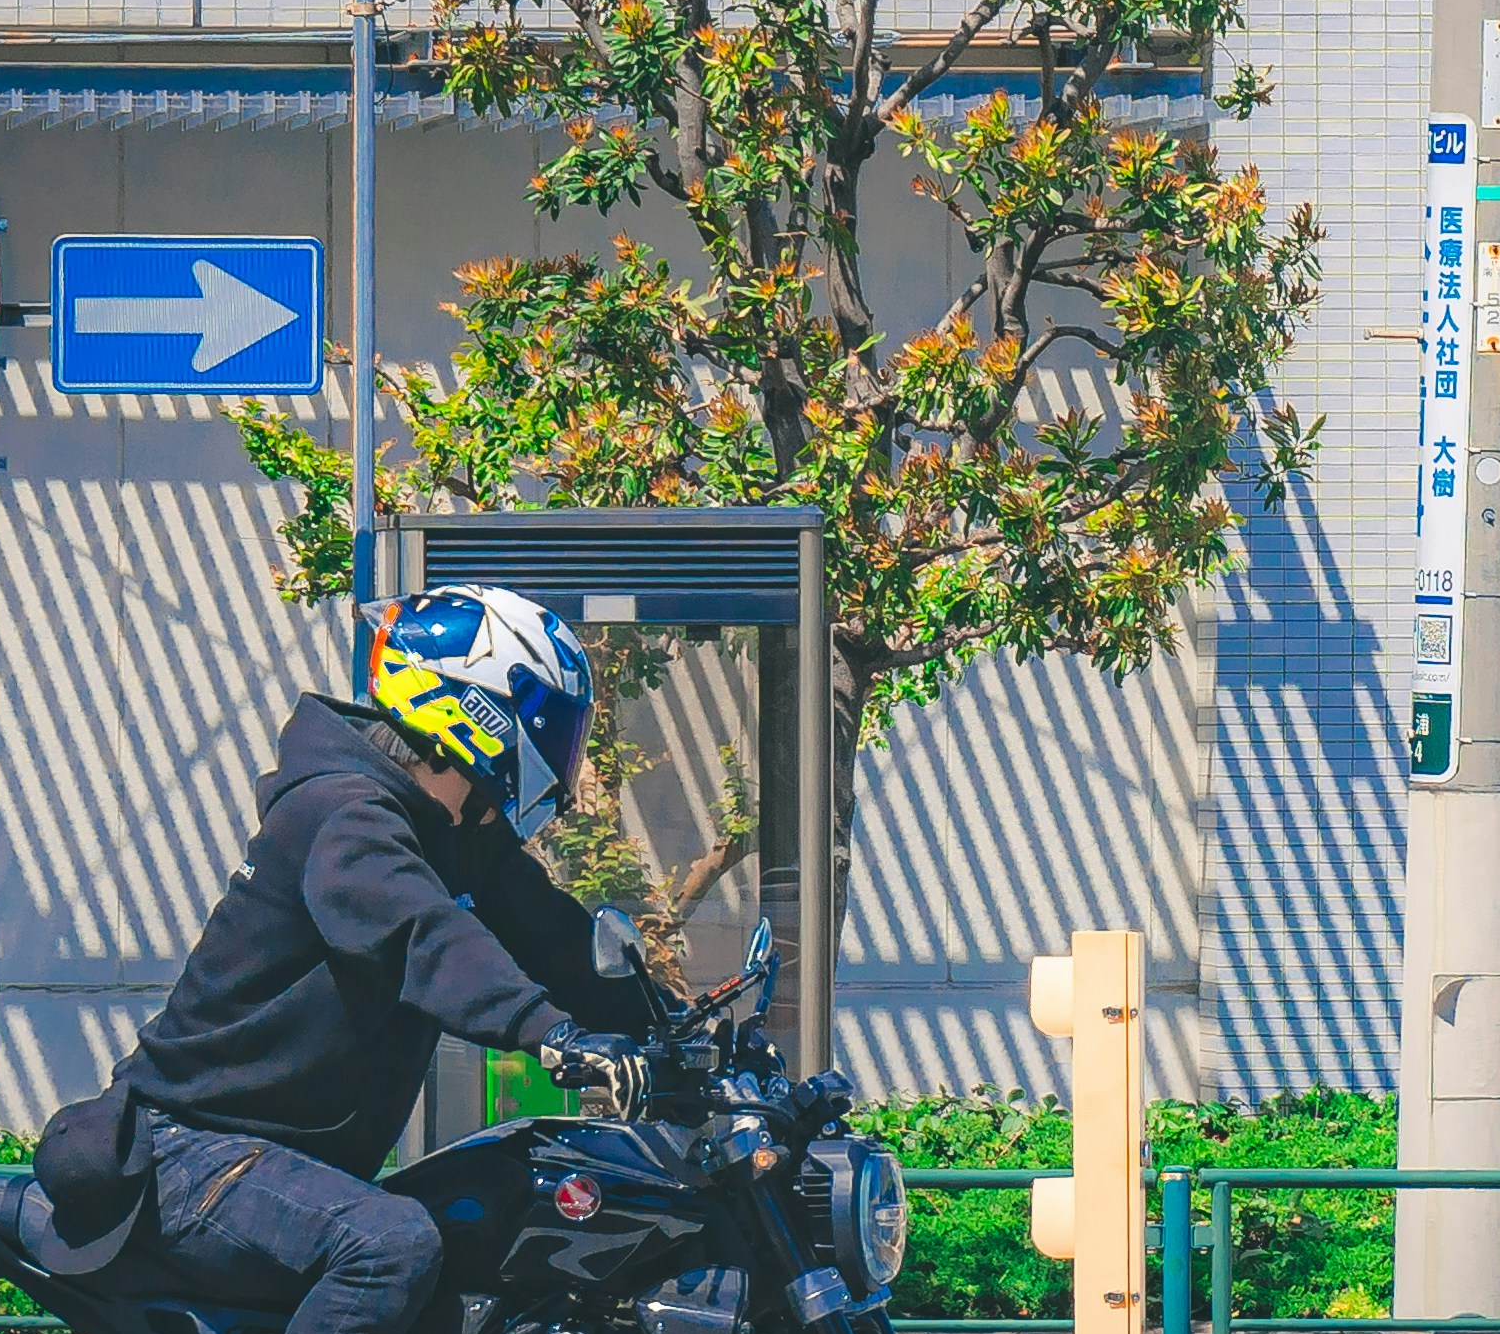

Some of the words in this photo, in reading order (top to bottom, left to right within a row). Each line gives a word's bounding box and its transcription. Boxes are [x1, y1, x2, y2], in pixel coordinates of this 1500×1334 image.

[1428, 129, 1465, 155] ビル
[1435, 206, 1463, 399] 医療法人社団
[1432, 435, 1456, 498] 大樹
